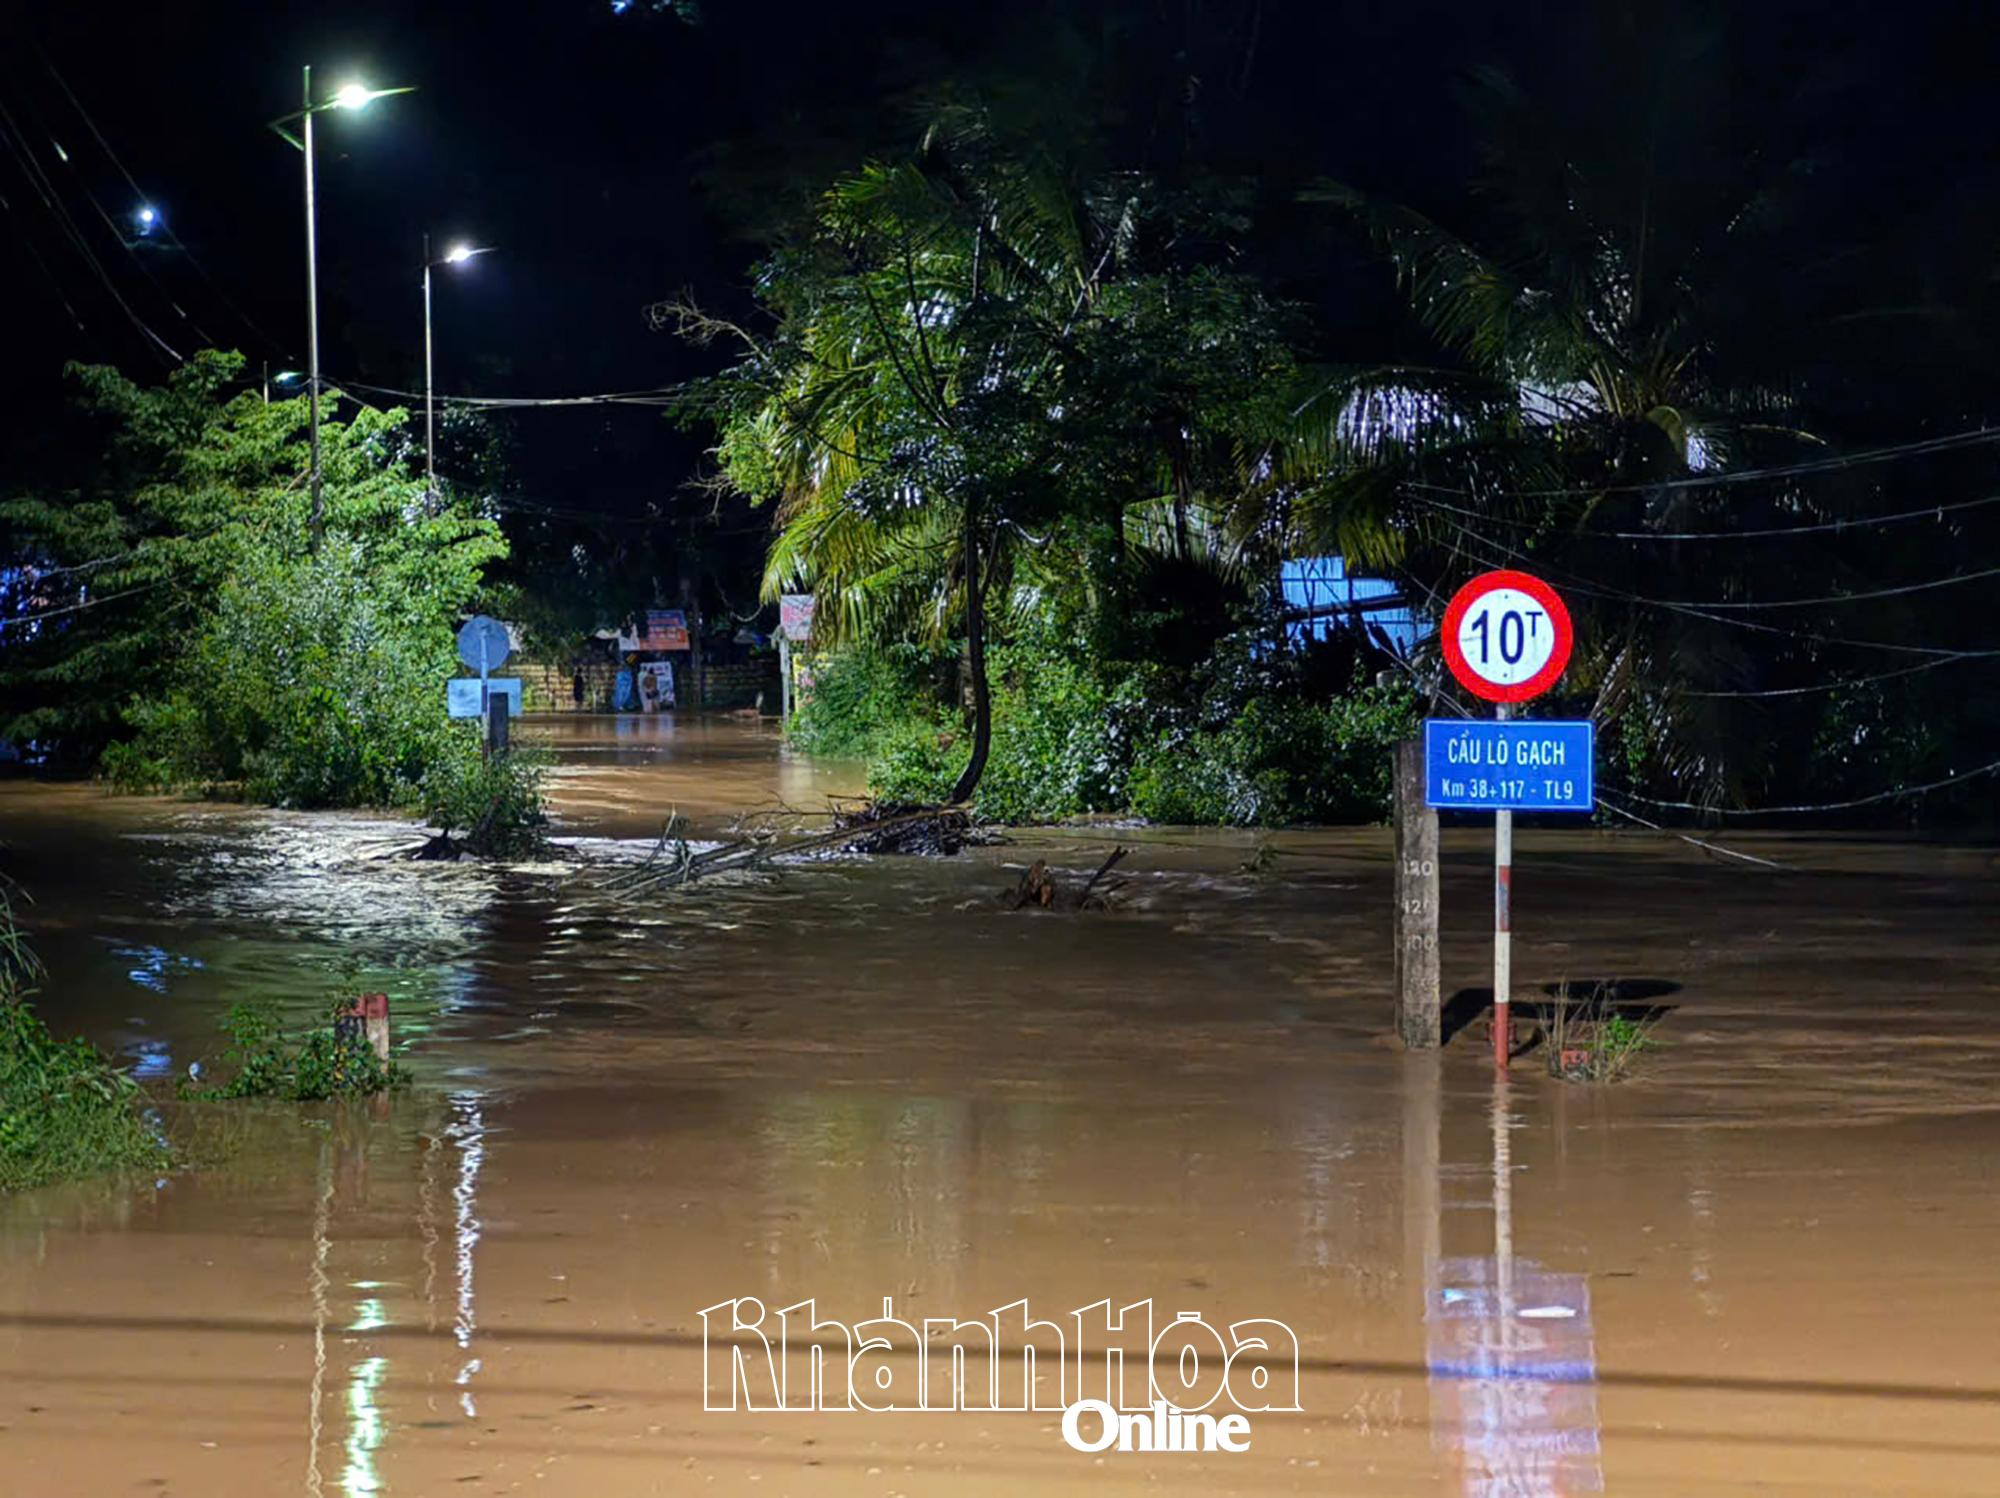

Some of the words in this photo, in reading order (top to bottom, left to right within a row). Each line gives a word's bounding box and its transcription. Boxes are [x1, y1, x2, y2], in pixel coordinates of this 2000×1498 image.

[1448, 729, 1480, 764] CẦU
[1487, 733, 1508, 765] LÒ
[1516, 740, 1565, 770] GẠCH
[1441, 778, 1464, 797] Km
[1544, 780, 1573, 800] TL9
